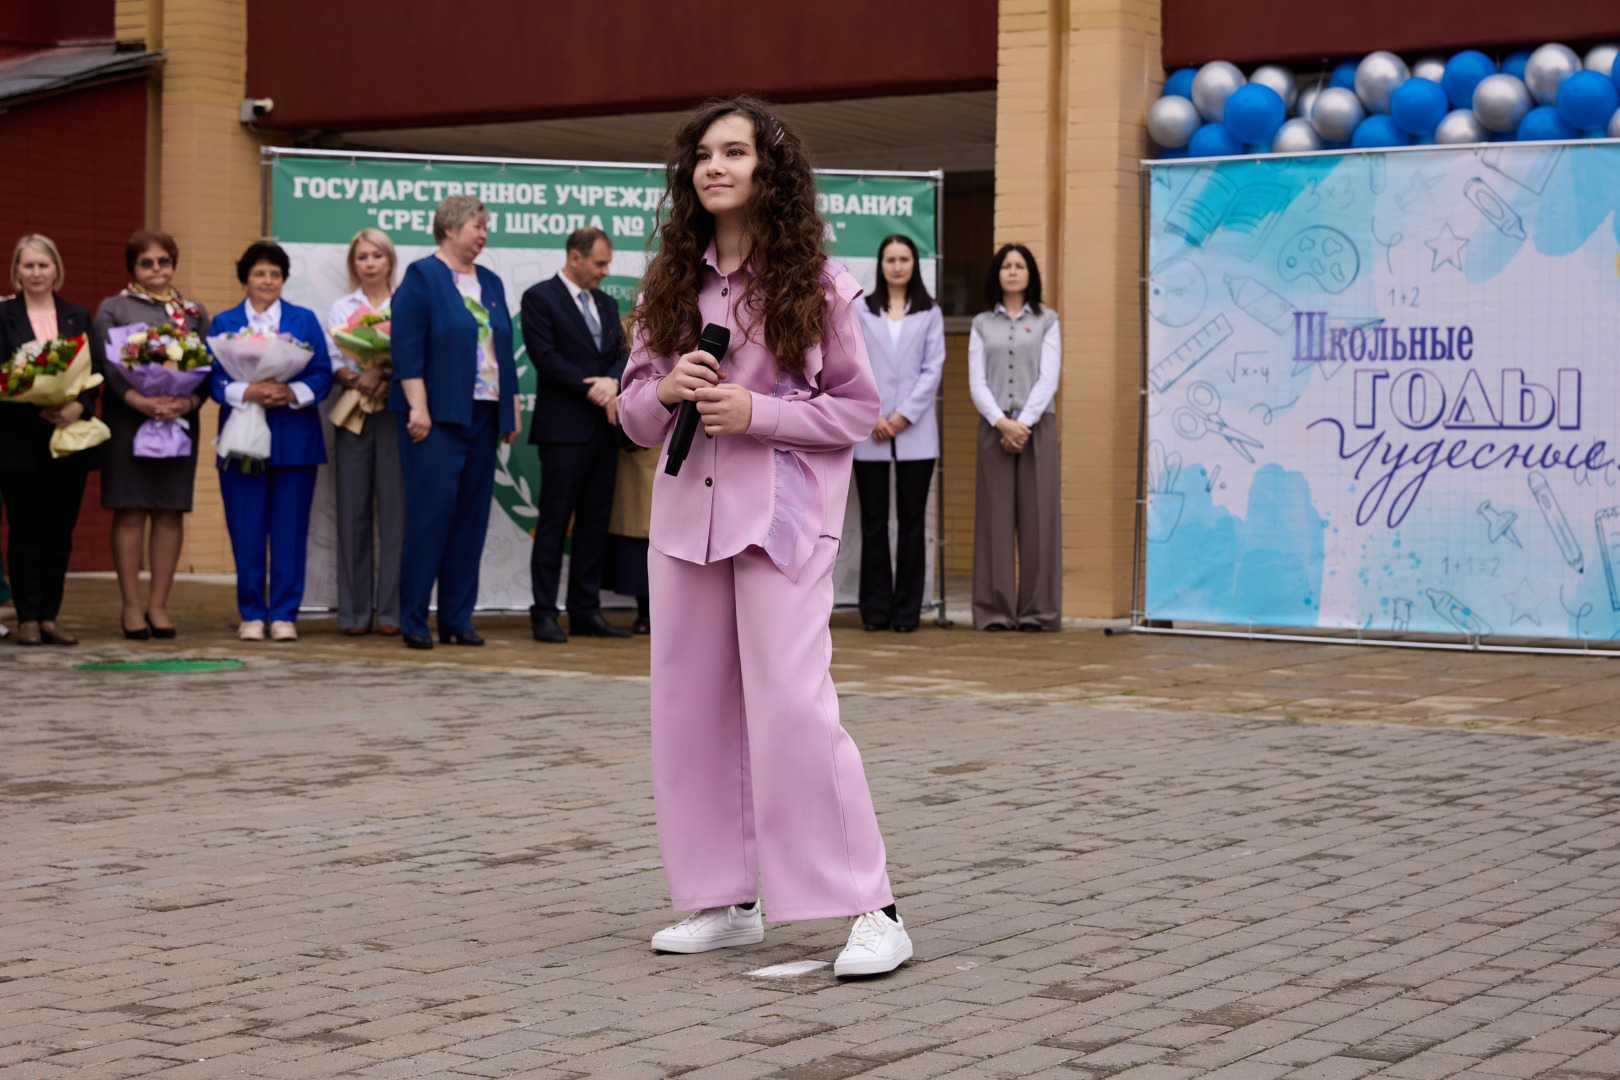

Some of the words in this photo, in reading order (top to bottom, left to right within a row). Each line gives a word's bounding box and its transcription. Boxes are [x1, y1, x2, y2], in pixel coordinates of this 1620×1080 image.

[293, 176, 548, 206] ГОСУДАРСТВЕННОЕ
[814, 193, 914, 217] ОВАНИЯ
[504, 212, 605, 236] ШКОЛА
[1292, 311, 1474, 362] Школьные
[1353, 367, 1582, 431] ГОДЫ
